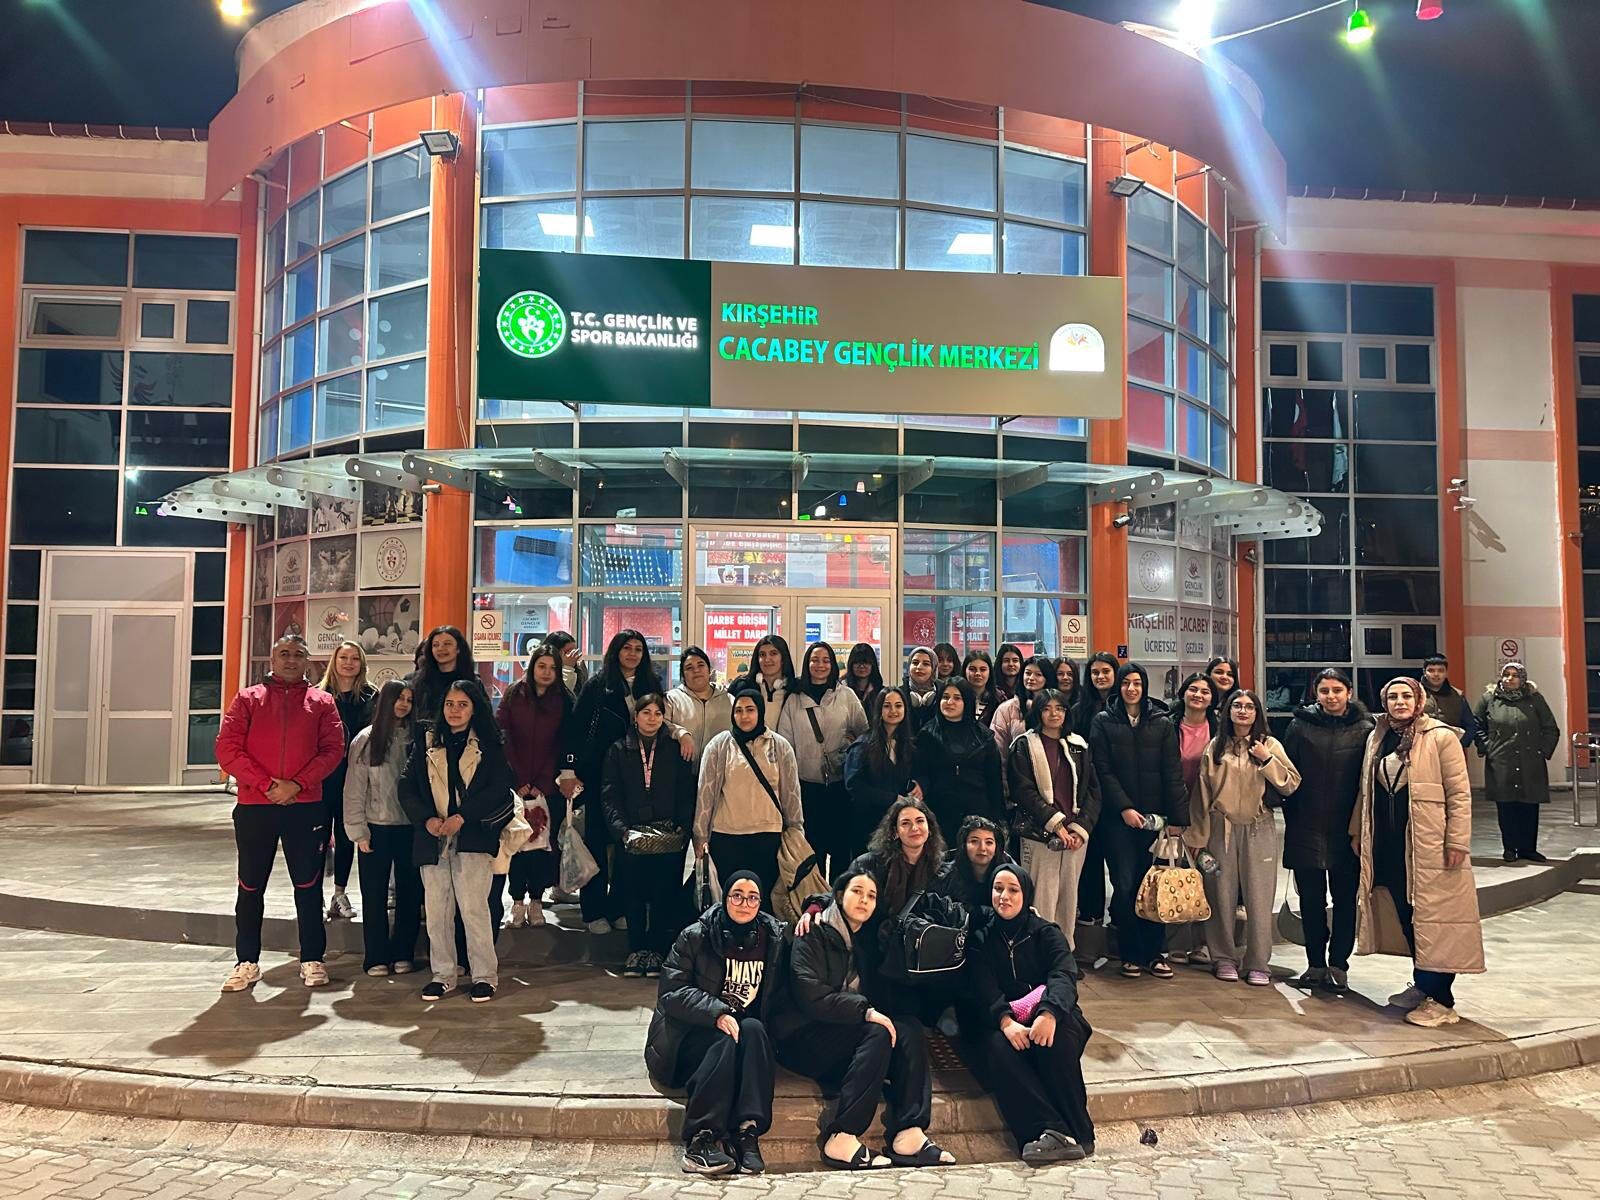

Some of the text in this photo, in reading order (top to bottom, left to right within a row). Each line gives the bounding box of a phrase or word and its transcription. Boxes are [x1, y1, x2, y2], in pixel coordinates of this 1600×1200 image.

[571, 312, 697, 331] T.C. GENÇLİK VE
[571, 329, 697, 348] SPOR BAKANLIĞI
[719, 336, 1039, 373] CACABEY GENÇLİK MERKEZİ
[708, 615, 735, 625] DARBE
[1128, 612, 1175, 633] KIRŞEHİR
[713, 627, 741, 639] MİLLET
[1144, 637, 1176, 652] ÜCRETSİZ
[726, 958, 764, 985] LWAYS
